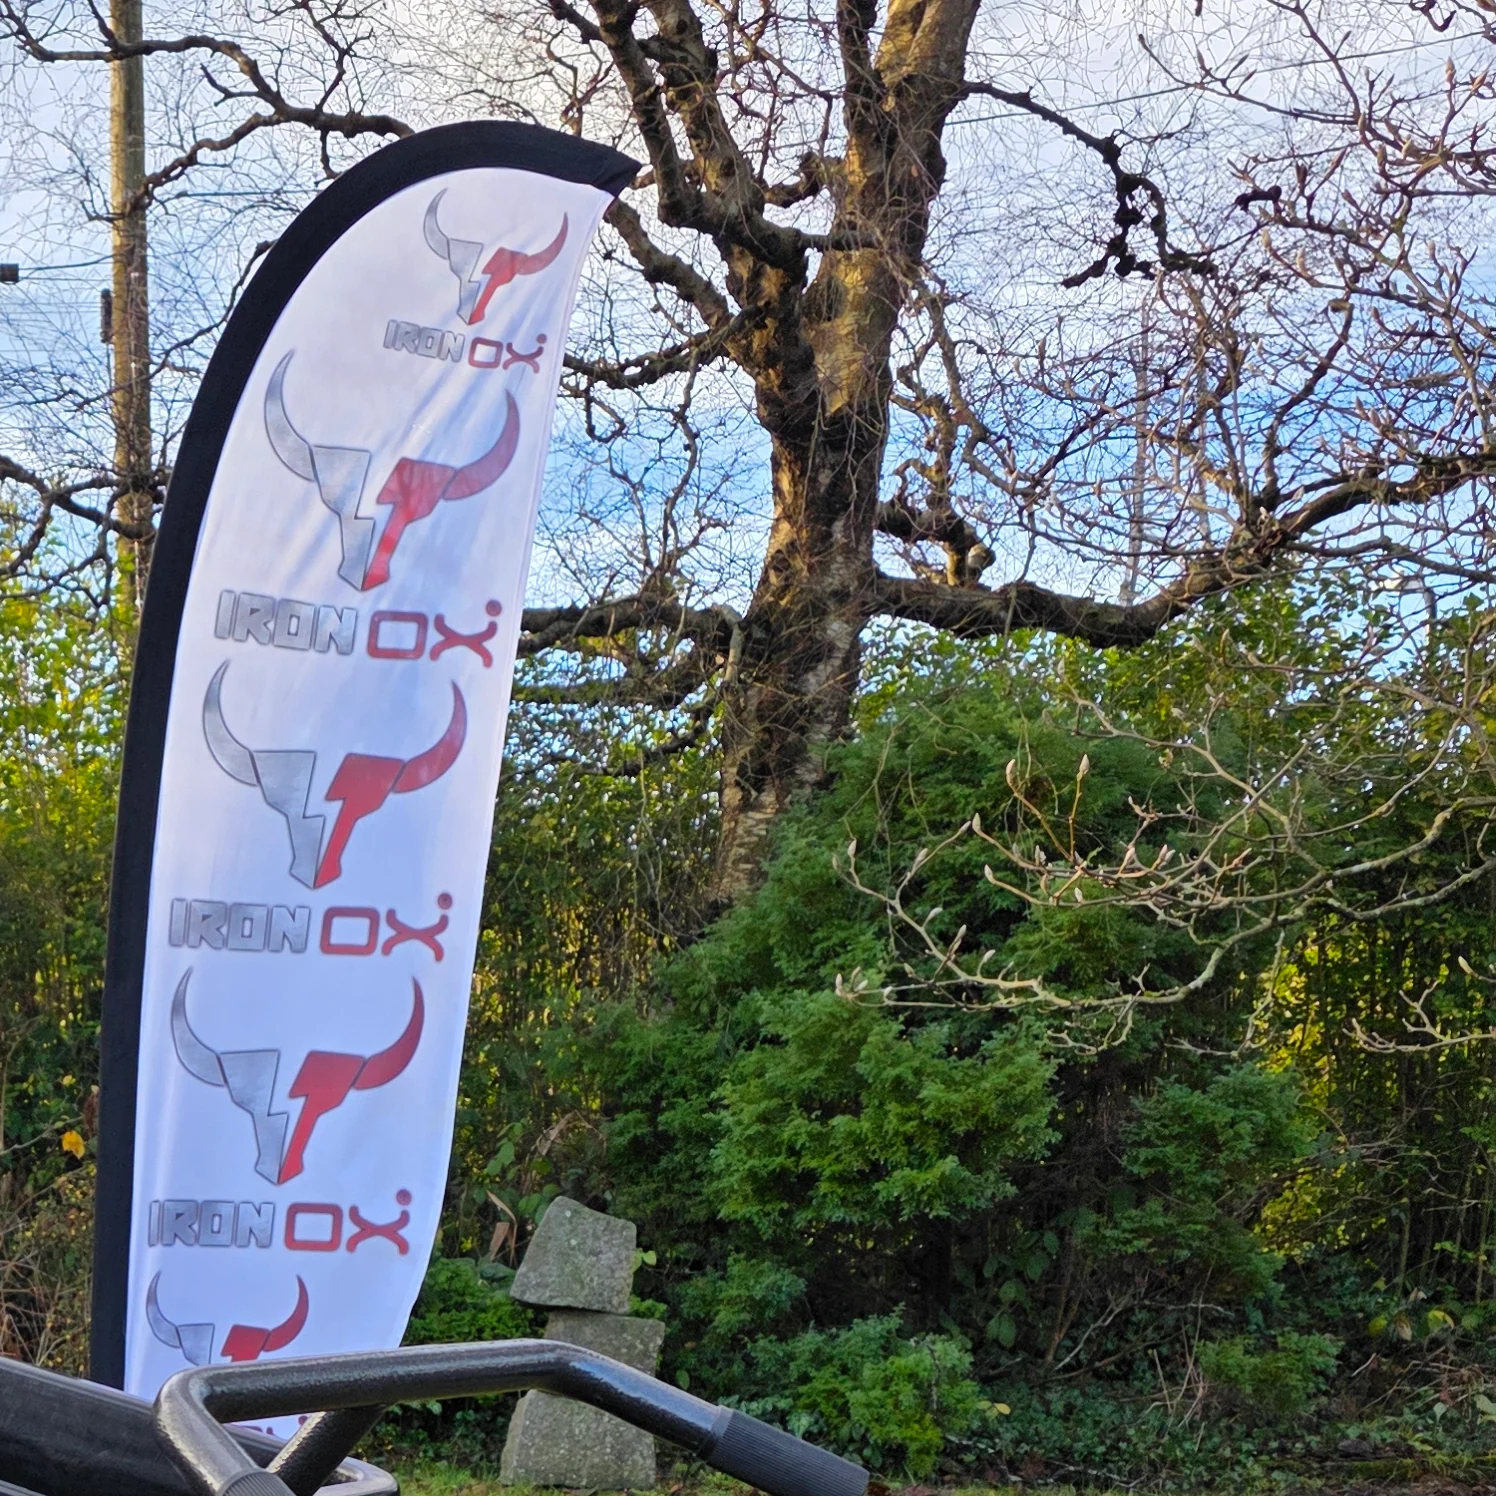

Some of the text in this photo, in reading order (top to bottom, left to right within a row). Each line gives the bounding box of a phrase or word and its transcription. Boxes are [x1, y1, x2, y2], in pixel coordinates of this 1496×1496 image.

[383, 319, 547, 374] IRON OX
[214, 589, 502, 668] IRON OX
[168, 892, 453, 962] IRON OX
[148, 1188, 412, 1256] IRON OX
